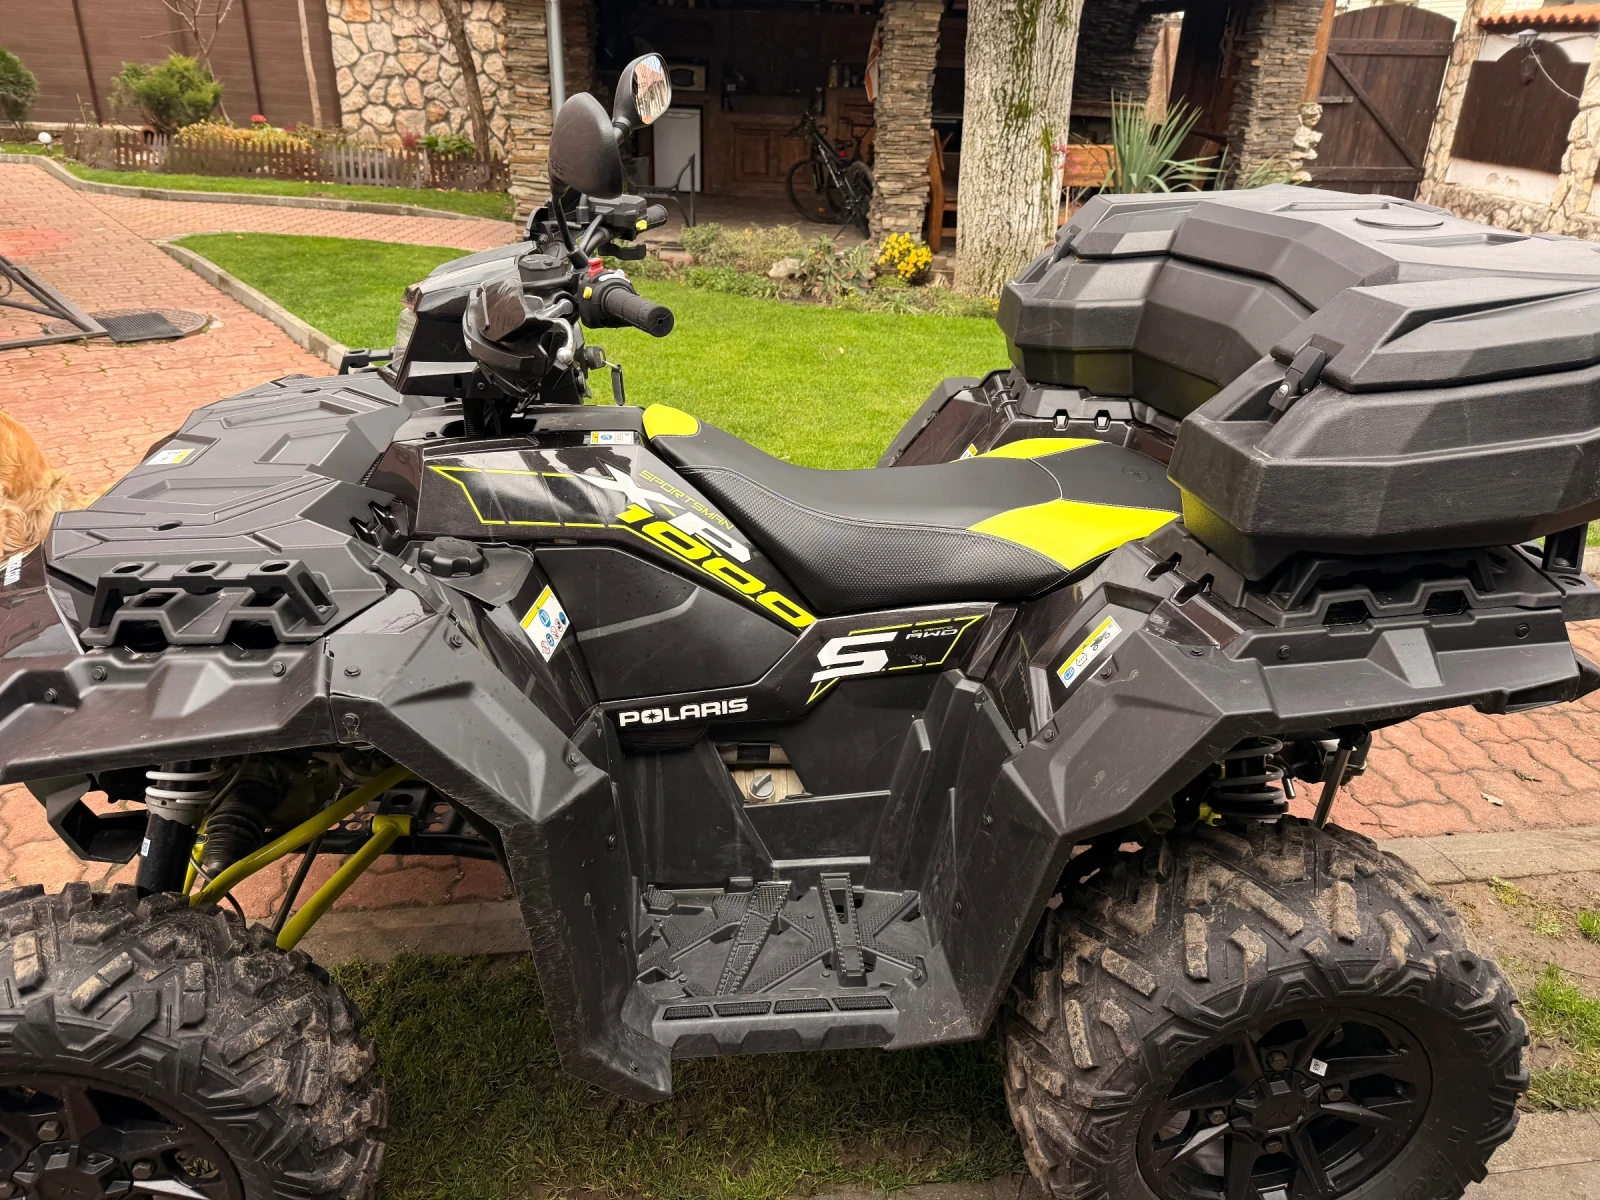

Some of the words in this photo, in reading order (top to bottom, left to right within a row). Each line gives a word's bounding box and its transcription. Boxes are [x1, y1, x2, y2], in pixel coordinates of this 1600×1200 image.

[639, 469, 735, 531] SPORTSMAN
[615, 503, 818, 628] 1000
[810, 631, 899, 684] S
[618, 697, 749, 727] POLARIS
